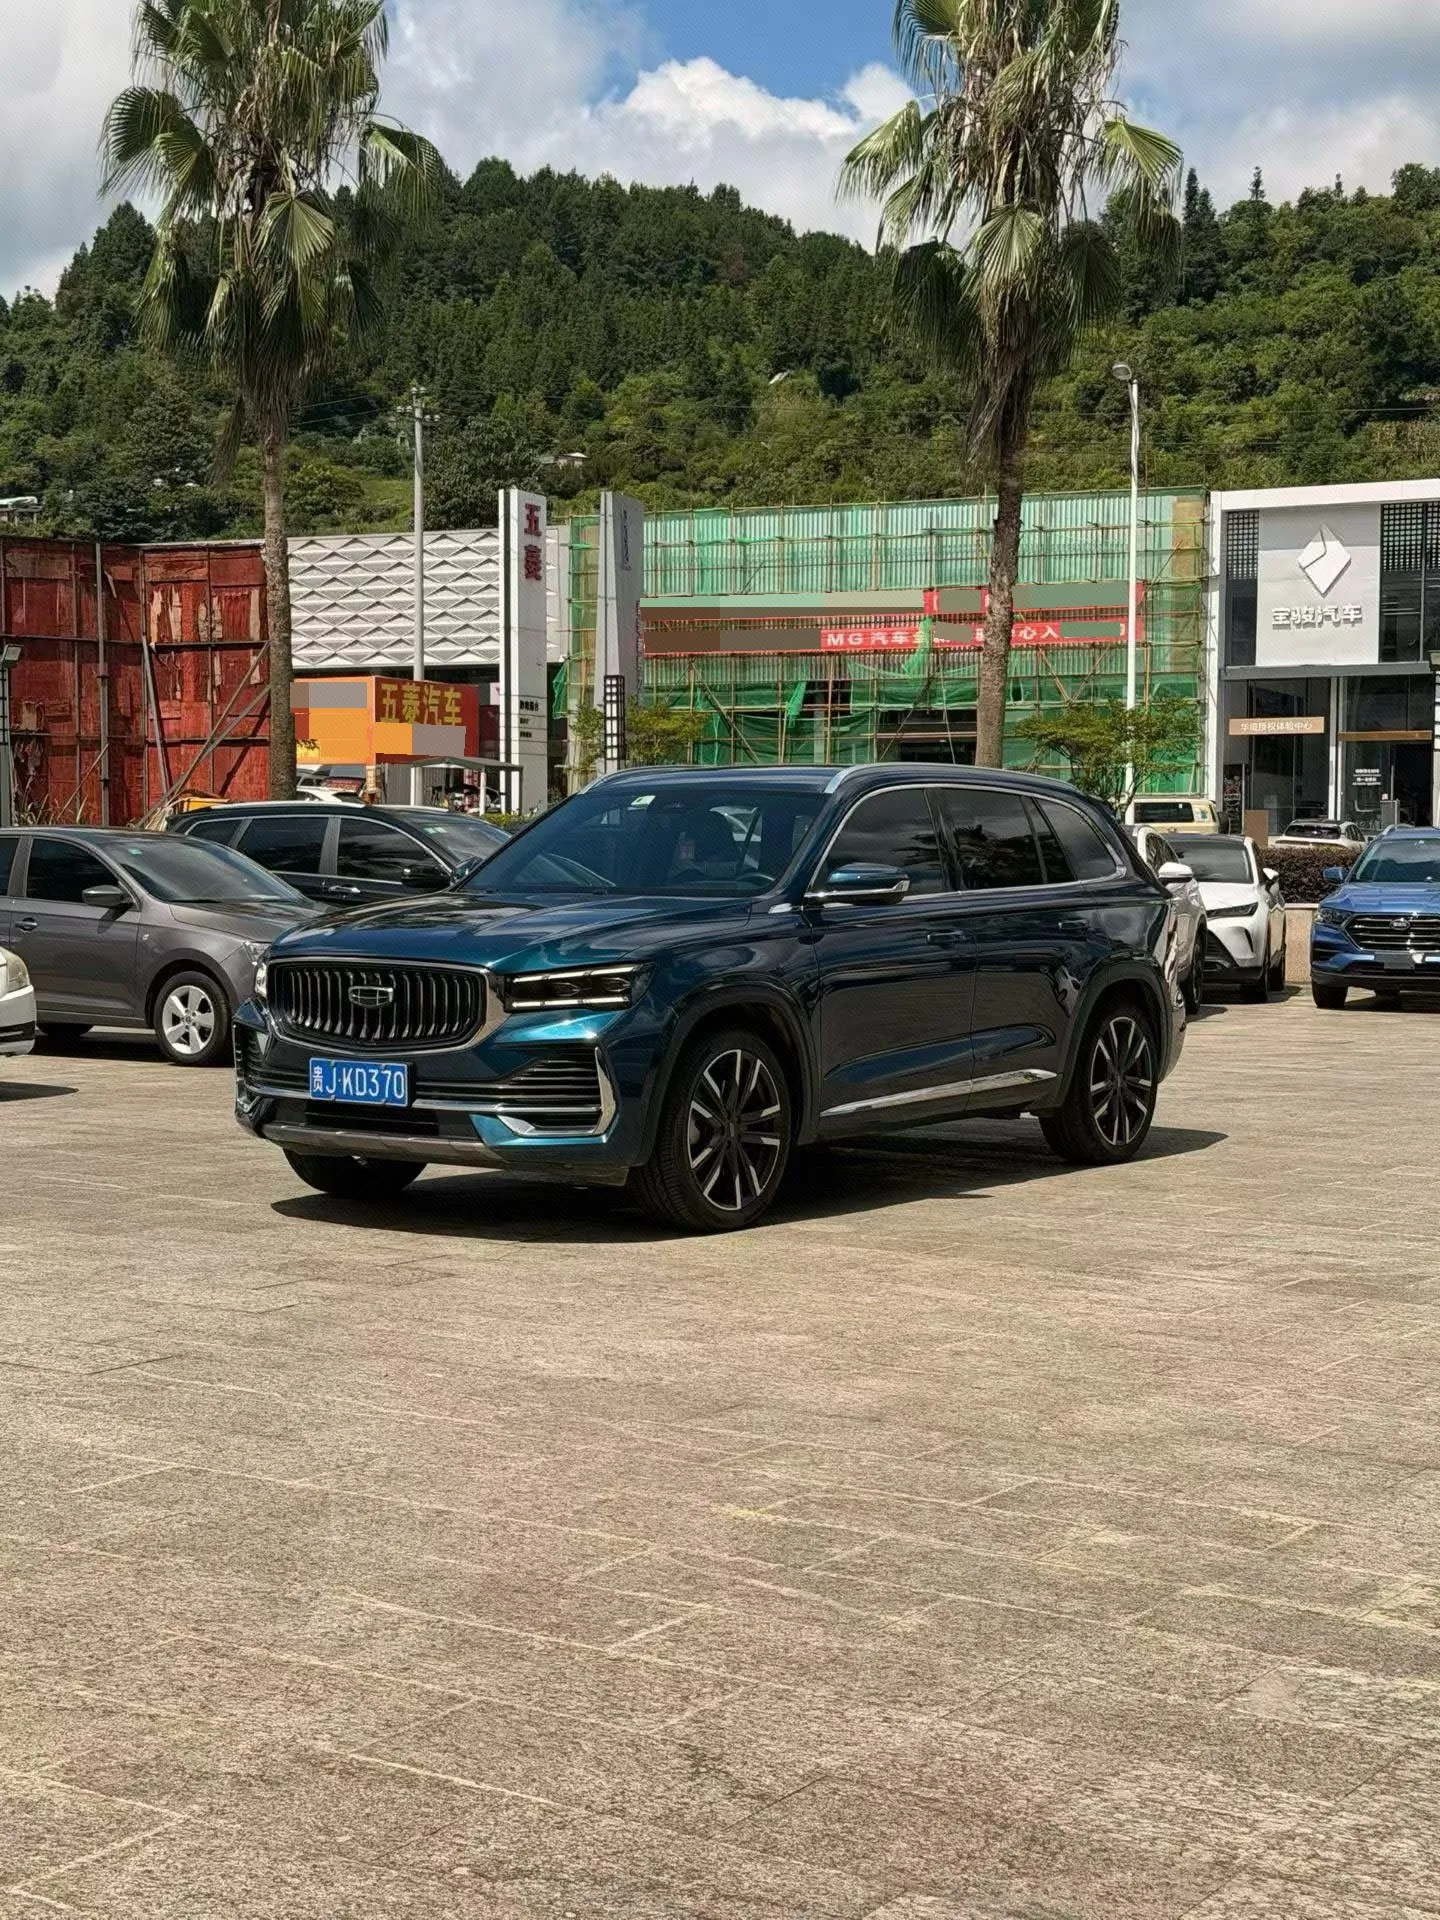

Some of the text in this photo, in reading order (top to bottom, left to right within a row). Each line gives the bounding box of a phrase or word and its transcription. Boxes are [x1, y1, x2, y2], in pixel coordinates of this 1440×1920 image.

[524, 503, 542, 581] 五菱
[1271, 603, 1362, 628] 宝骏汽车
[380, 682, 463, 726] 五菱汽车
